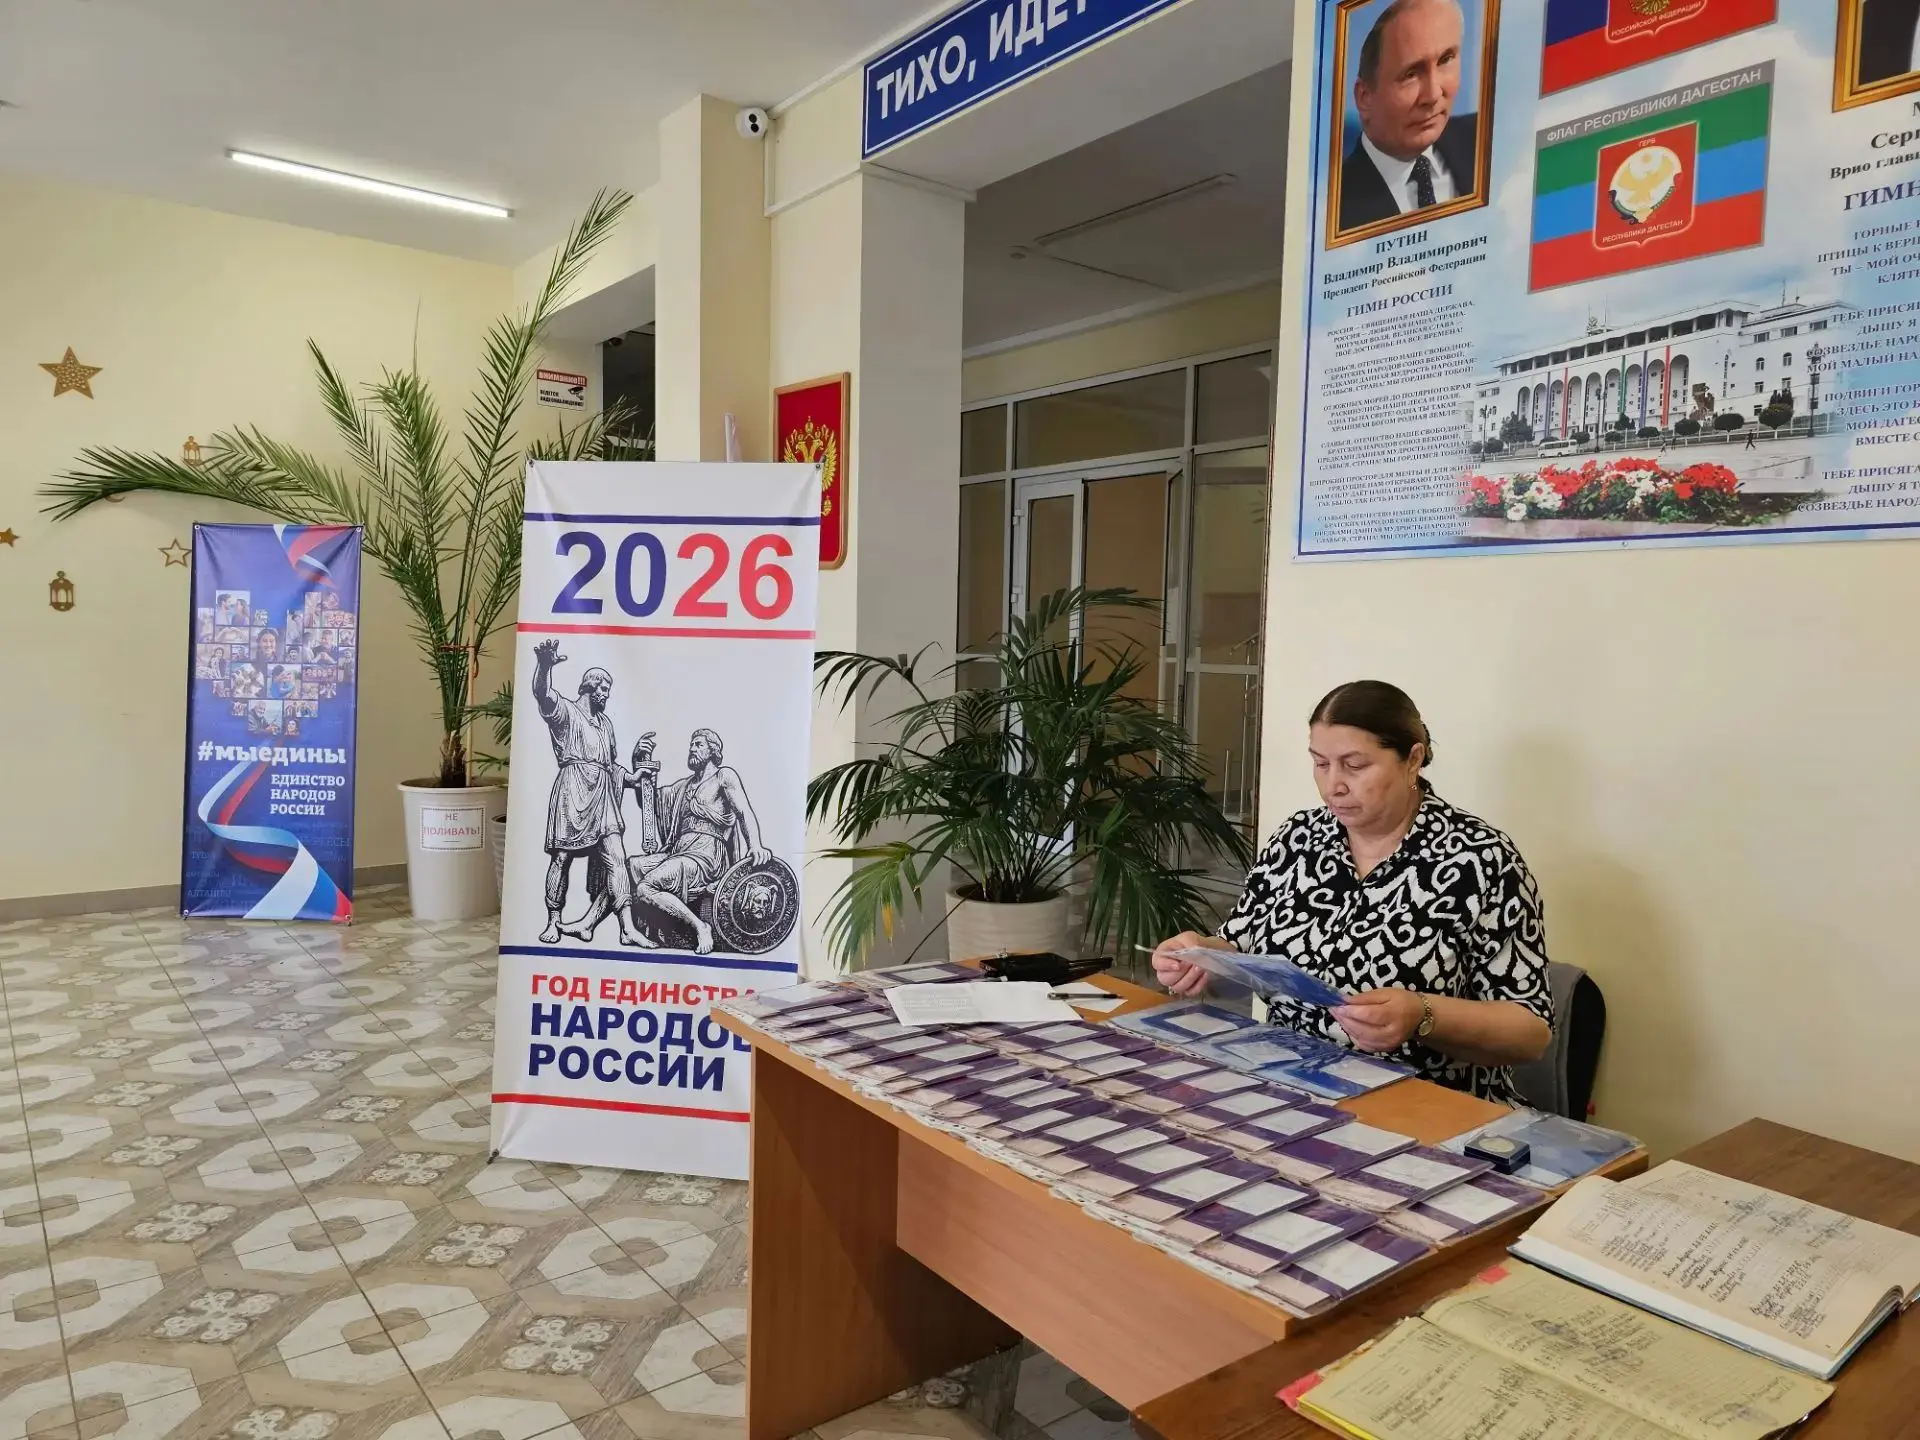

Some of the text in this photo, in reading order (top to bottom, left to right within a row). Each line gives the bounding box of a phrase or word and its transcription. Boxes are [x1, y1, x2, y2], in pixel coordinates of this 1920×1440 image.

[1611, 15, 1657, 37] РОССИЙСКОЙ
[876, 0, 1086, 120] ТИХО, ИДЕ
[1547, 68, 1762, 141] ФЛАГ РЕСПУБЛИКИ ДАГЕСТАН
[1639, 138, 1656, 146] ГЕРБ
[1830, 162, 1871, 180] Врио
[1602, 220, 1683, 243] РЕСПУБЛИКИ ДАГЕСТАН
[1854, 220, 1912, 240] ГОРНЫЕ
[1376, 230, 1428, 254] ПУТИН
[1324, 235, 1488, 285] Владимир Владимирович
[1817, 247, 1868, 263] ПТИЦЫ
[1873, 242, 1882, 253] К
[1831, 265, 1851, 277] ТЫ
[1866, 255, 1899, 270] МОЙ
[1323, 254, 1487, 300] Президент Российской Федерации
[1346, 283, 1454, 318] ГИМН РОССИИ
[1831, 310, 1864, 323] ТЕБЕ
[1857, 318, 1917, 336] ДЫШУ Я
[1807, 360, 1837, 373] МОЙ
[1841, 352, 1894, 369] МАЛЫЙ
[1825, 386, 1890, 402] ПОДВИГИ
[1836, 404, 1879, 416] ЗДЕСЬ
[1882, 401, 1909, 412] ЭТО
[1846, 420, 1877, 431] МОЙ
[1856, 433, 1910, 446] ВМЕСТЕ
[1822, 470, 1855, 480] ТЕБЕ
[1848, 483, 1895, 495] ДЫШУ
[1898, 482, 1907, 490] Я
[1797, 499, 1873, 512] СОЗВЕЗДЬЕ
[551, 531, 794, 620] 2026
[271, 774, 345, 787] ЕДИНСТВО
[270, 789, 336, 803] НАРОДОВ
[270, 804, 325, 816] РОССИИ
[445, 813, 459, 821] НЕ
[424, 826, 480, 836] ПОЛИВАТЬ!
[531, 974, 755, 1006] ГОД ЕДИНСТВ
[528, 1043, 725, 1092] РОССИИ
